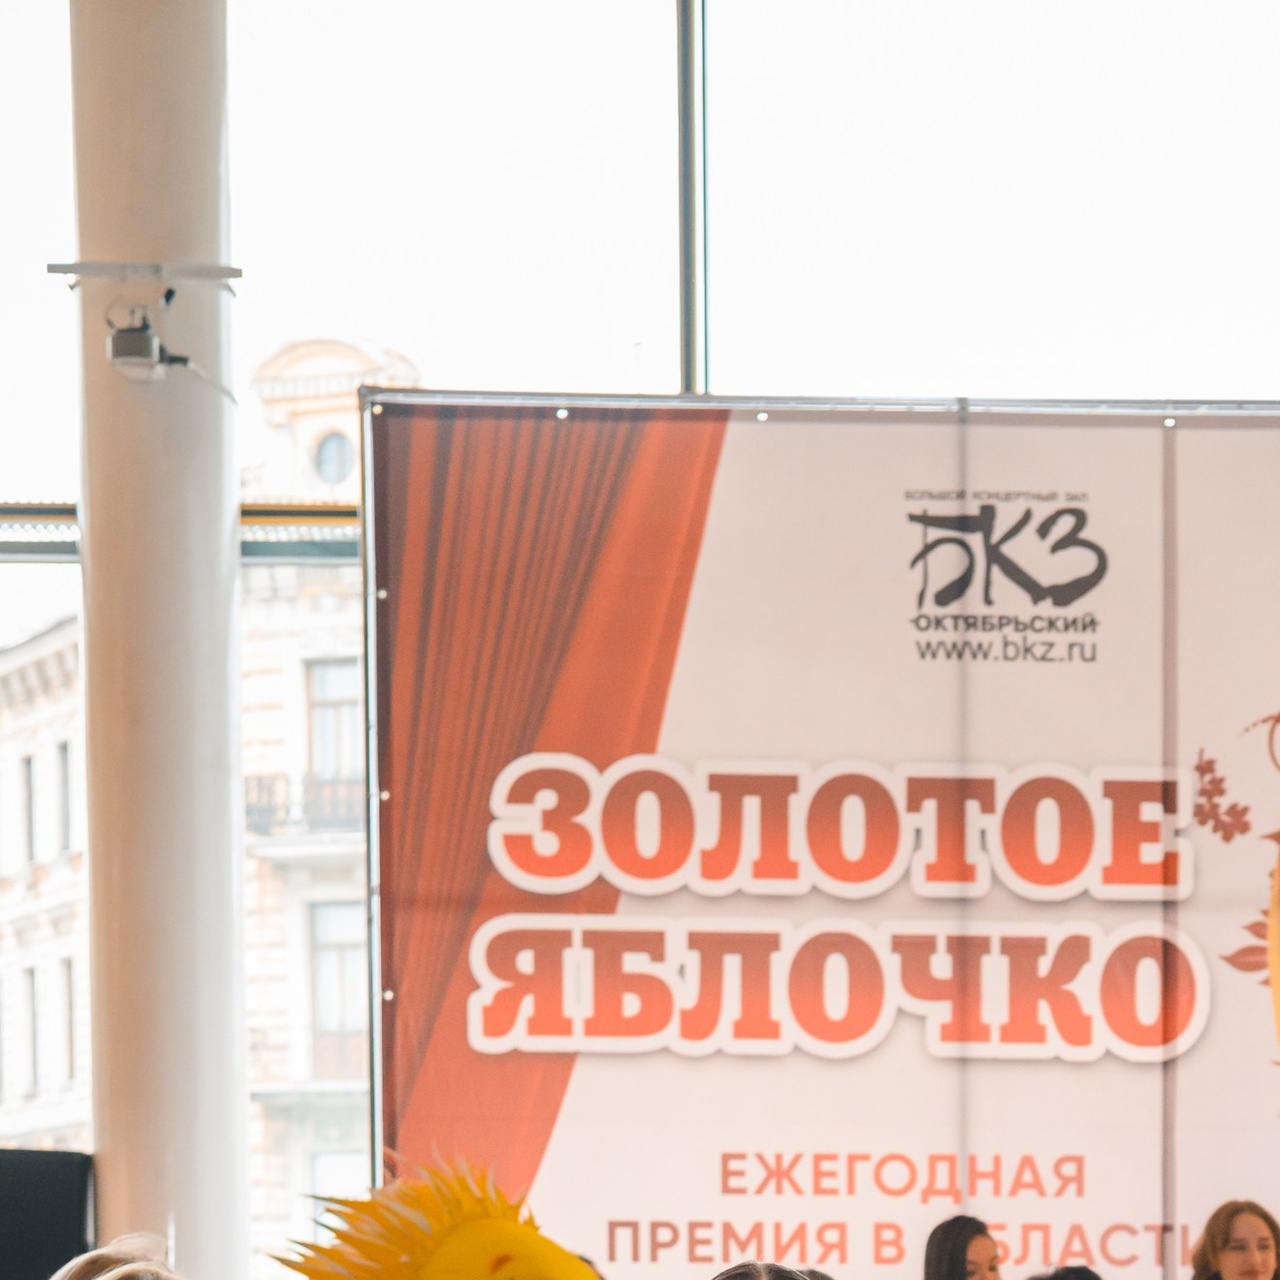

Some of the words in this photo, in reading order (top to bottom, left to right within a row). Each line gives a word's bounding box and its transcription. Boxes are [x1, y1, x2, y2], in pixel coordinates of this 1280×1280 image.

[907, 504, 1108, 610] БКЗ
[913, 613, 1099, 633] ОКТЯБРЬСКИЙ
[915, 635, 1098, 663] www.bkz.ru
[502, 767, 1181, 888] ЗОЛОТОЕ
[481, 927, 1198, 1049] ЯБЛОЧКО
[719, 1151, 1087, 1205] ЕЖЕГОДНАЯ
[606, 1220, 848, 1265] ПРЕМИЯ
[874, 1222, 906, 1265] В
